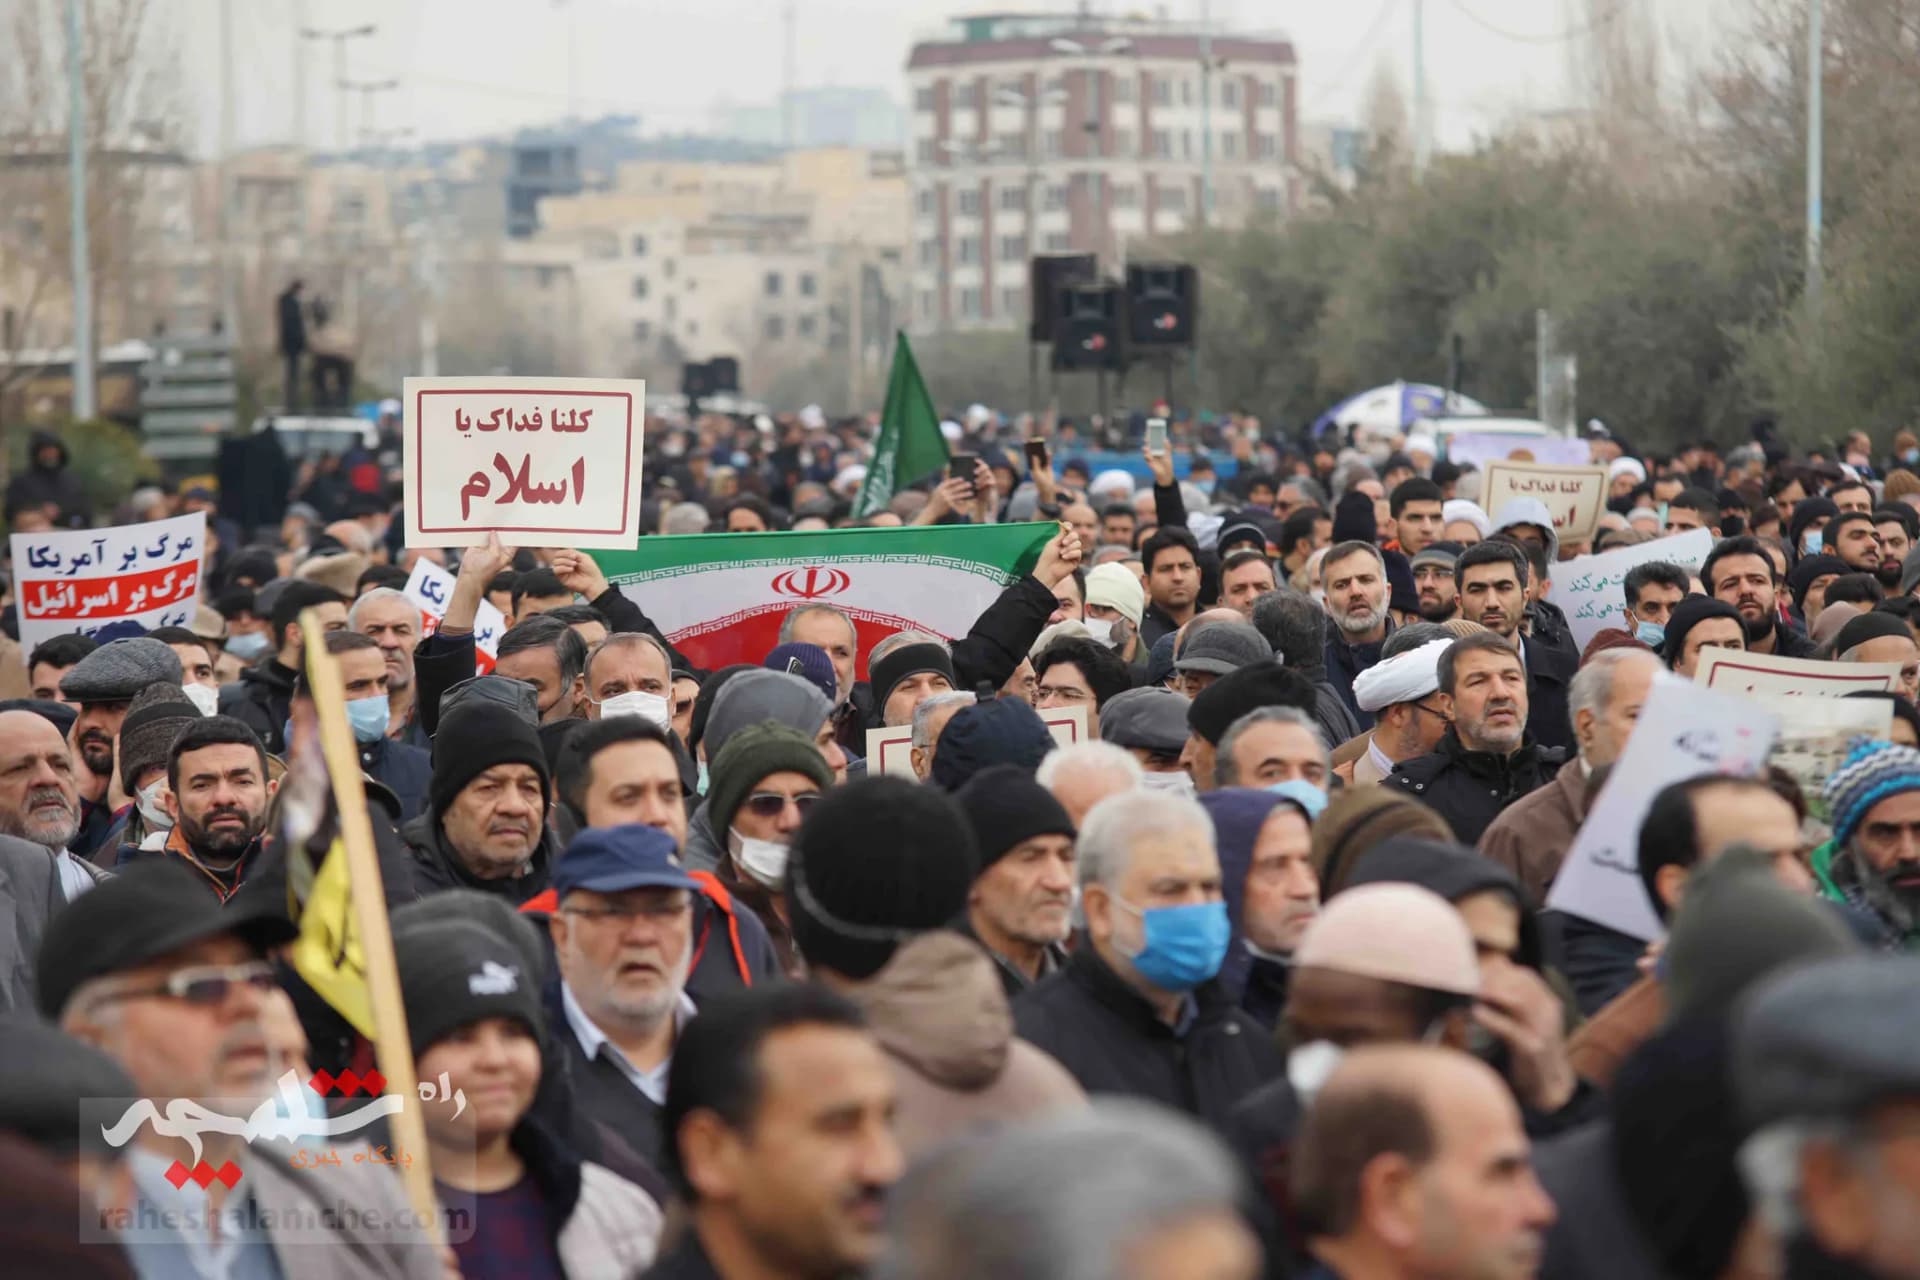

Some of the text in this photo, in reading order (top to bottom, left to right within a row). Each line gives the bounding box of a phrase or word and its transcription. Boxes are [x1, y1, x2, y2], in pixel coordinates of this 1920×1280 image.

[455, 406, 593, 438] کلنا فداک یا
[460, 452, 585, 521] اسلام
[27, 531, 193, 575] مرگ بر آمریکا
[26, 569, 196, 616] مرگ بر اسرائیل
